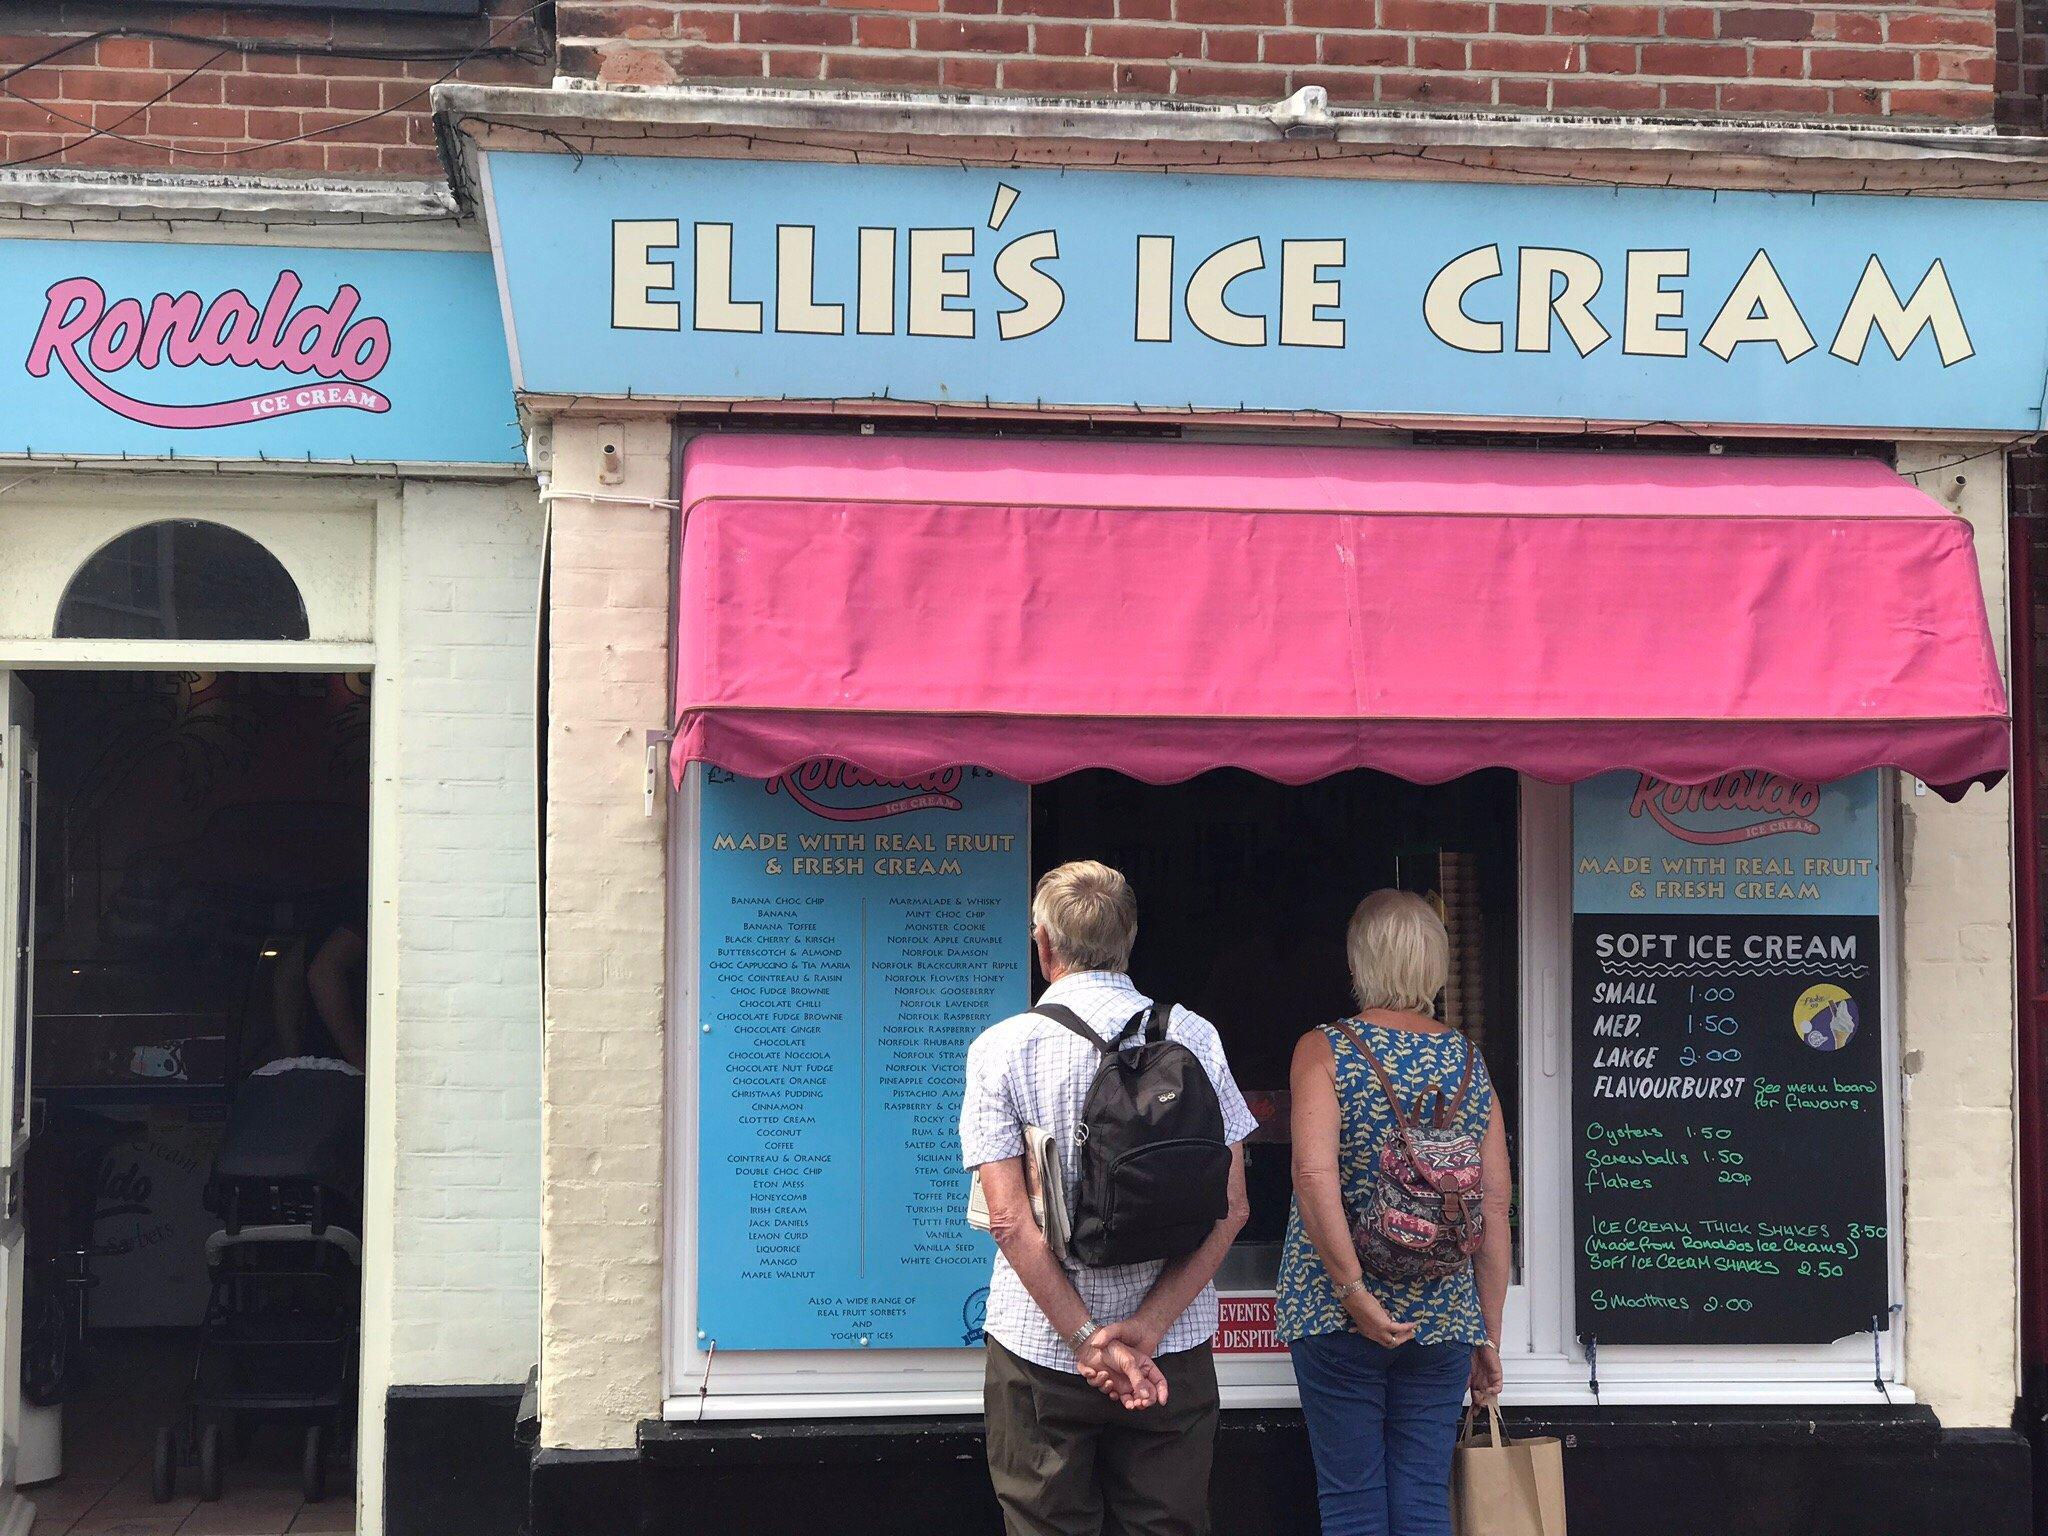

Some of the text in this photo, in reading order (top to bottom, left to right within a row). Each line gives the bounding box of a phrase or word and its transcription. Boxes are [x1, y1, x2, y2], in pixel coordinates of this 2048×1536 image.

[610, 183, 1977, 369] ELLIE'S ICE CREAM
[25, 269, 392, 390] Ronaldo
[250, 383, 377, 416] ICE CREAM
[886, 795, 956, 813] ICE CREAM
[1746, 820, 1815, 837] ICE CREAM
[713, 833, 1015, 852] MADE WITH REAL FRUIT
[765, 858, 963, 876] & FRESH CREAM
[1578, 857, 1872, 876] MADE WITH REAL FRUIT
[1629, 881, 1821, 900] & FRESH CREAM
[731, 895, 825, 905] BANANA CHOC CHIP
[757, 909, 798, 918] BANANA
[905, 910, 986, 919] MINT CHOC CHIP
[743, 922, 817, 931] BANANA TOFFEE
[904, 923, 986, 932] MONSTER COOKIE
[887, 935, 1003, 944] NORFOLK APPLE CRUMBLE
[1595, 933, 1857, 959] SOFT ICE CREAM
[901, 948, 990, 957] NORFOLK DAMSON
[730, 986, 830, 996] CHOC FUDGE BROWNIE
[1592, 982, 1735, 1004] SMALL 1.00
[739, 999, 821, 1008] CHOCOLATE CHILLI
[899, 999, 989, 1008] NORFOLK LAVENDER
[716, 1012, 844, 1021] CHOCOLATE FUDGE BROWNIE
[898, 1012, 992, 1021] NORFOLK RASPBERRY
[733, 1025, 822, 1034] CHOCOLATE GINGER
[1593, 1014, 1739, 1038] MED. 1.50
[753, 1038, 806, 1047] CHOCOLATE
[728, 1050, 831, 1060] CHOCOLATE NOCCIOLA
[1593, 1046, 1742, 1069] LARGE 2.00
[725, 1063, 834, 1073] CHOCOLATE NUT FUDGE
[732, 1076, 827, 1086] CHOCOLATE ORANGE
[879, 1076, 967, 1085] PINEAPPLE COCONU
[1593, 1075, 1746, 1099] FLAVOURBURST
[731, 1089, 824, 1099] CHRISTMAS PUDDING
[751, 1102, 804, 1111] CINNAMON
[738, 1115, 816, 1124] CLOTTED CREAM
[756, 1128, 803, 1137] COCONUT
[1586, 1122, 1732, 1147] Oysters 1.50
[764, 1141, 794, 1150] COFFEE
[1584, 1148, 1744, 1168] Screwballs 1.50
[735, 1166, 823, 1176] DOUBLE CHOC CHIP
[753, 1180, 805, 1189] ETON MESS
[929, 1179, 959, 1188] TOFFEE
[750, 1193, 808, 1202] HONEYCOMB
[912, 1191, 968, 1201] TOFFEE PECA
[750, 1205, 808, 1215] IRISH CREAM
[749, 1218, 809, 1228] JACK DANIELS
[912, 1217, 967, 1227] TUTTI FRUT
[1592, 1215, 1888, 1239] ICE CREAM THICK SHAKES 3.50
[748, 1231, 809, 1241] LEMON CURD
[925, 1230, 963, 1239] VANILLA
[756, 1244, 801, 1254] LIQUORICE
[913, 1243, 975, 1252] VANILLA SEED
[759, 1258, 798, 1266] MANGO
[900, 1256, 988, 1265] WHITE CHOCOLATE
[741, 1270, 816, 1280] MAPLE WALNUT
[808, 1297, 916, 1305] ALSO A WIDE RANGE OF
[1590, 1288, 1753, 1312] Smoothies 2.00
[817, 1309, 839, 1317] REAL
[851, 1320, 873, 1328] AND
[830, 1332, 874, 1340] YOGHURT
[1224, 1330, 1280, 1348] DESPITE
